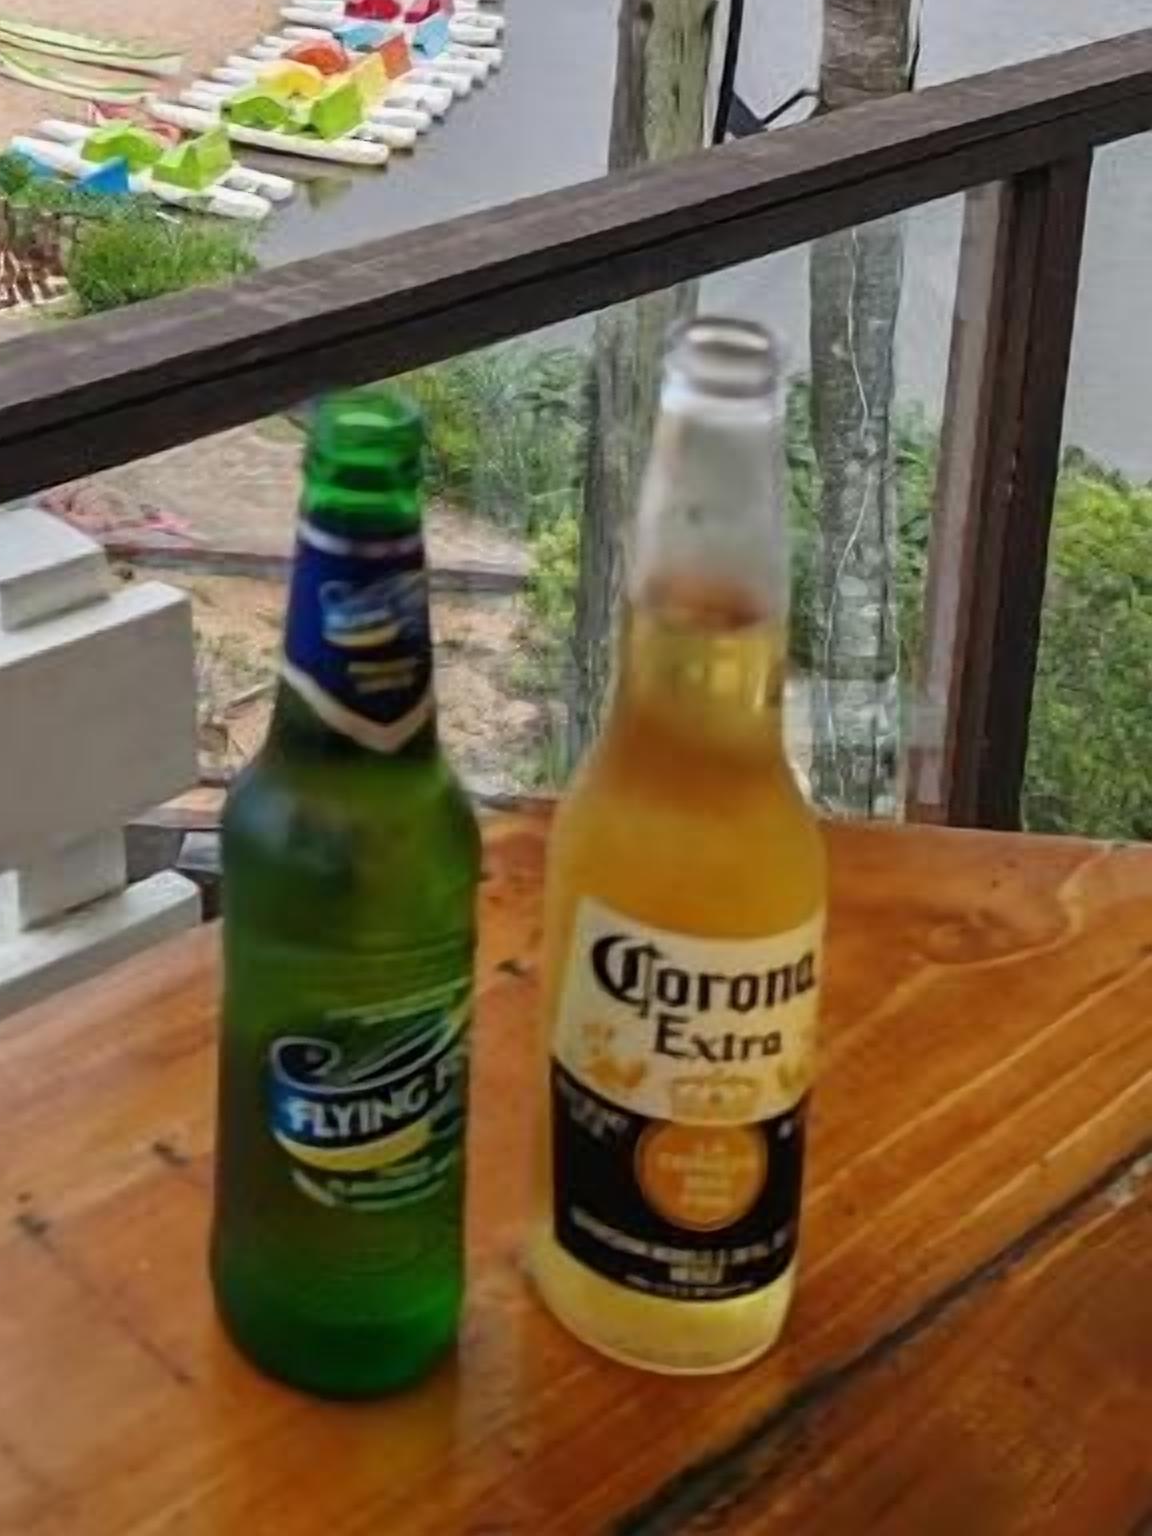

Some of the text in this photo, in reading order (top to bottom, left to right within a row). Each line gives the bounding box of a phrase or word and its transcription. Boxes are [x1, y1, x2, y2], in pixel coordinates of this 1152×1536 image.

[592, 935, 815, 1018] Corona
[654, 1013, 783, 1062] Extra
[282, 1076, 430, 1139] FLYING
